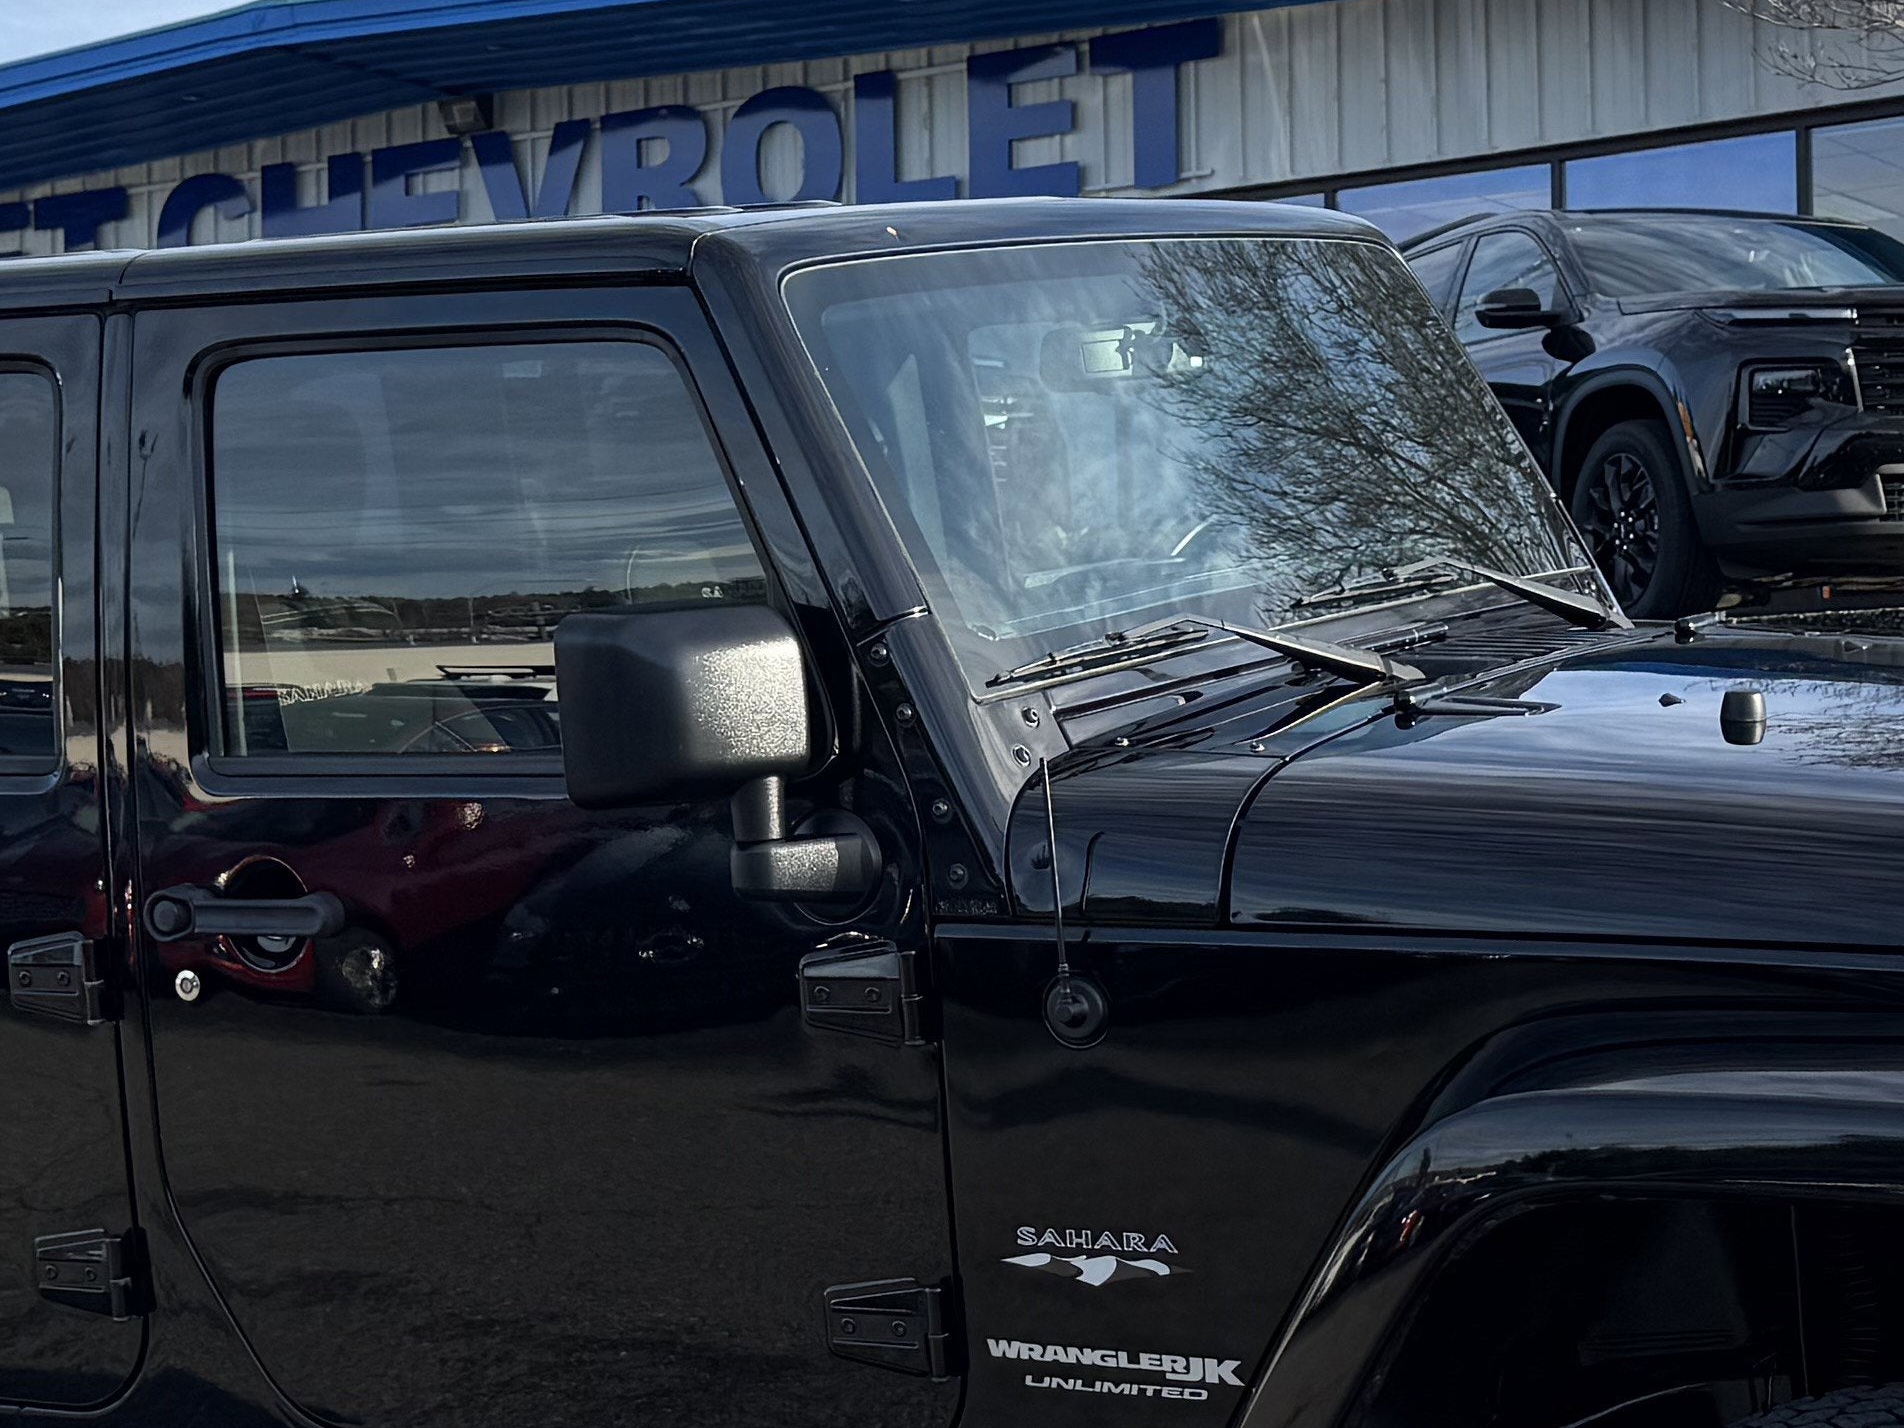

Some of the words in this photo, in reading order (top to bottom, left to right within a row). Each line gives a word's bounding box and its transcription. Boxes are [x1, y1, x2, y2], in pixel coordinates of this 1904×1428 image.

[156, 16, 1223, 248] CHEVROLET
[1016, 1226, 1178, 1254] SAHARA
[1025, 1375, 1208, 1401] UNLIMITED
